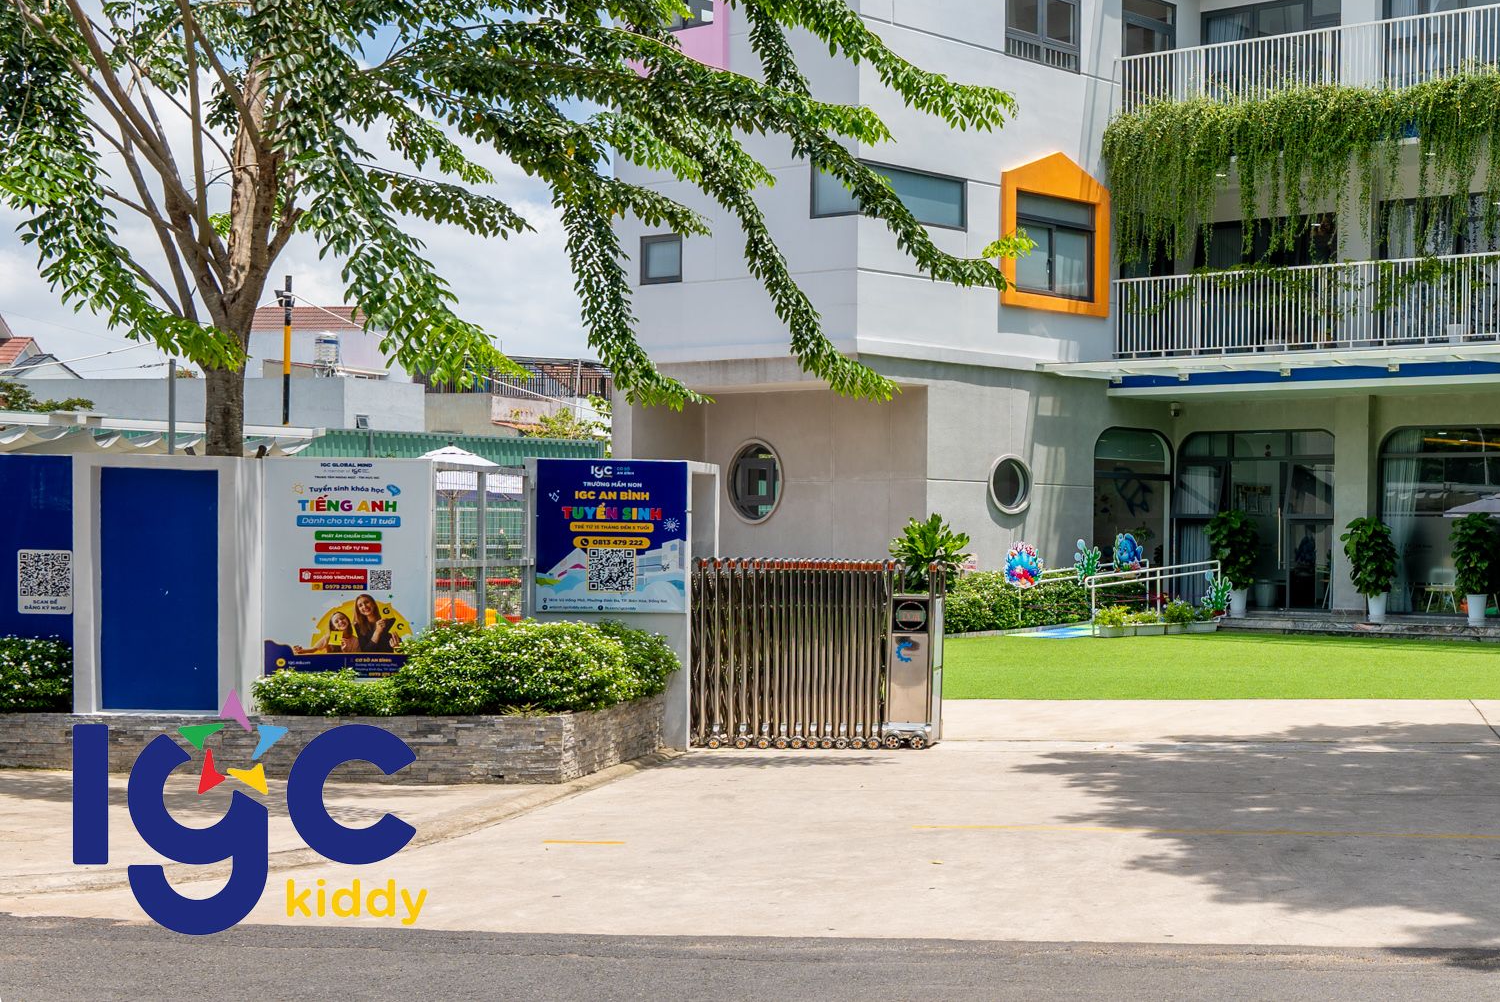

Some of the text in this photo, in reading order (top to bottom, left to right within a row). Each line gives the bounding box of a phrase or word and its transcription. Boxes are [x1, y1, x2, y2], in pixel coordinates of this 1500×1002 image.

[309, 484, 332, 493] Tuyển
[371, 486, 385, 494] học
[575, 489, 650, 501] IGC AN BÌNH
[298, 495, 398, 512] TIẾNG ANH
[562, 502, 663, 521] TUYỂN SINH
[302, 517, 325, 525] Dành
[327, 517, 342, 525] cho
[344, 517, 355, 525] trẻ
[379, 517, 396, 525] tuổi
